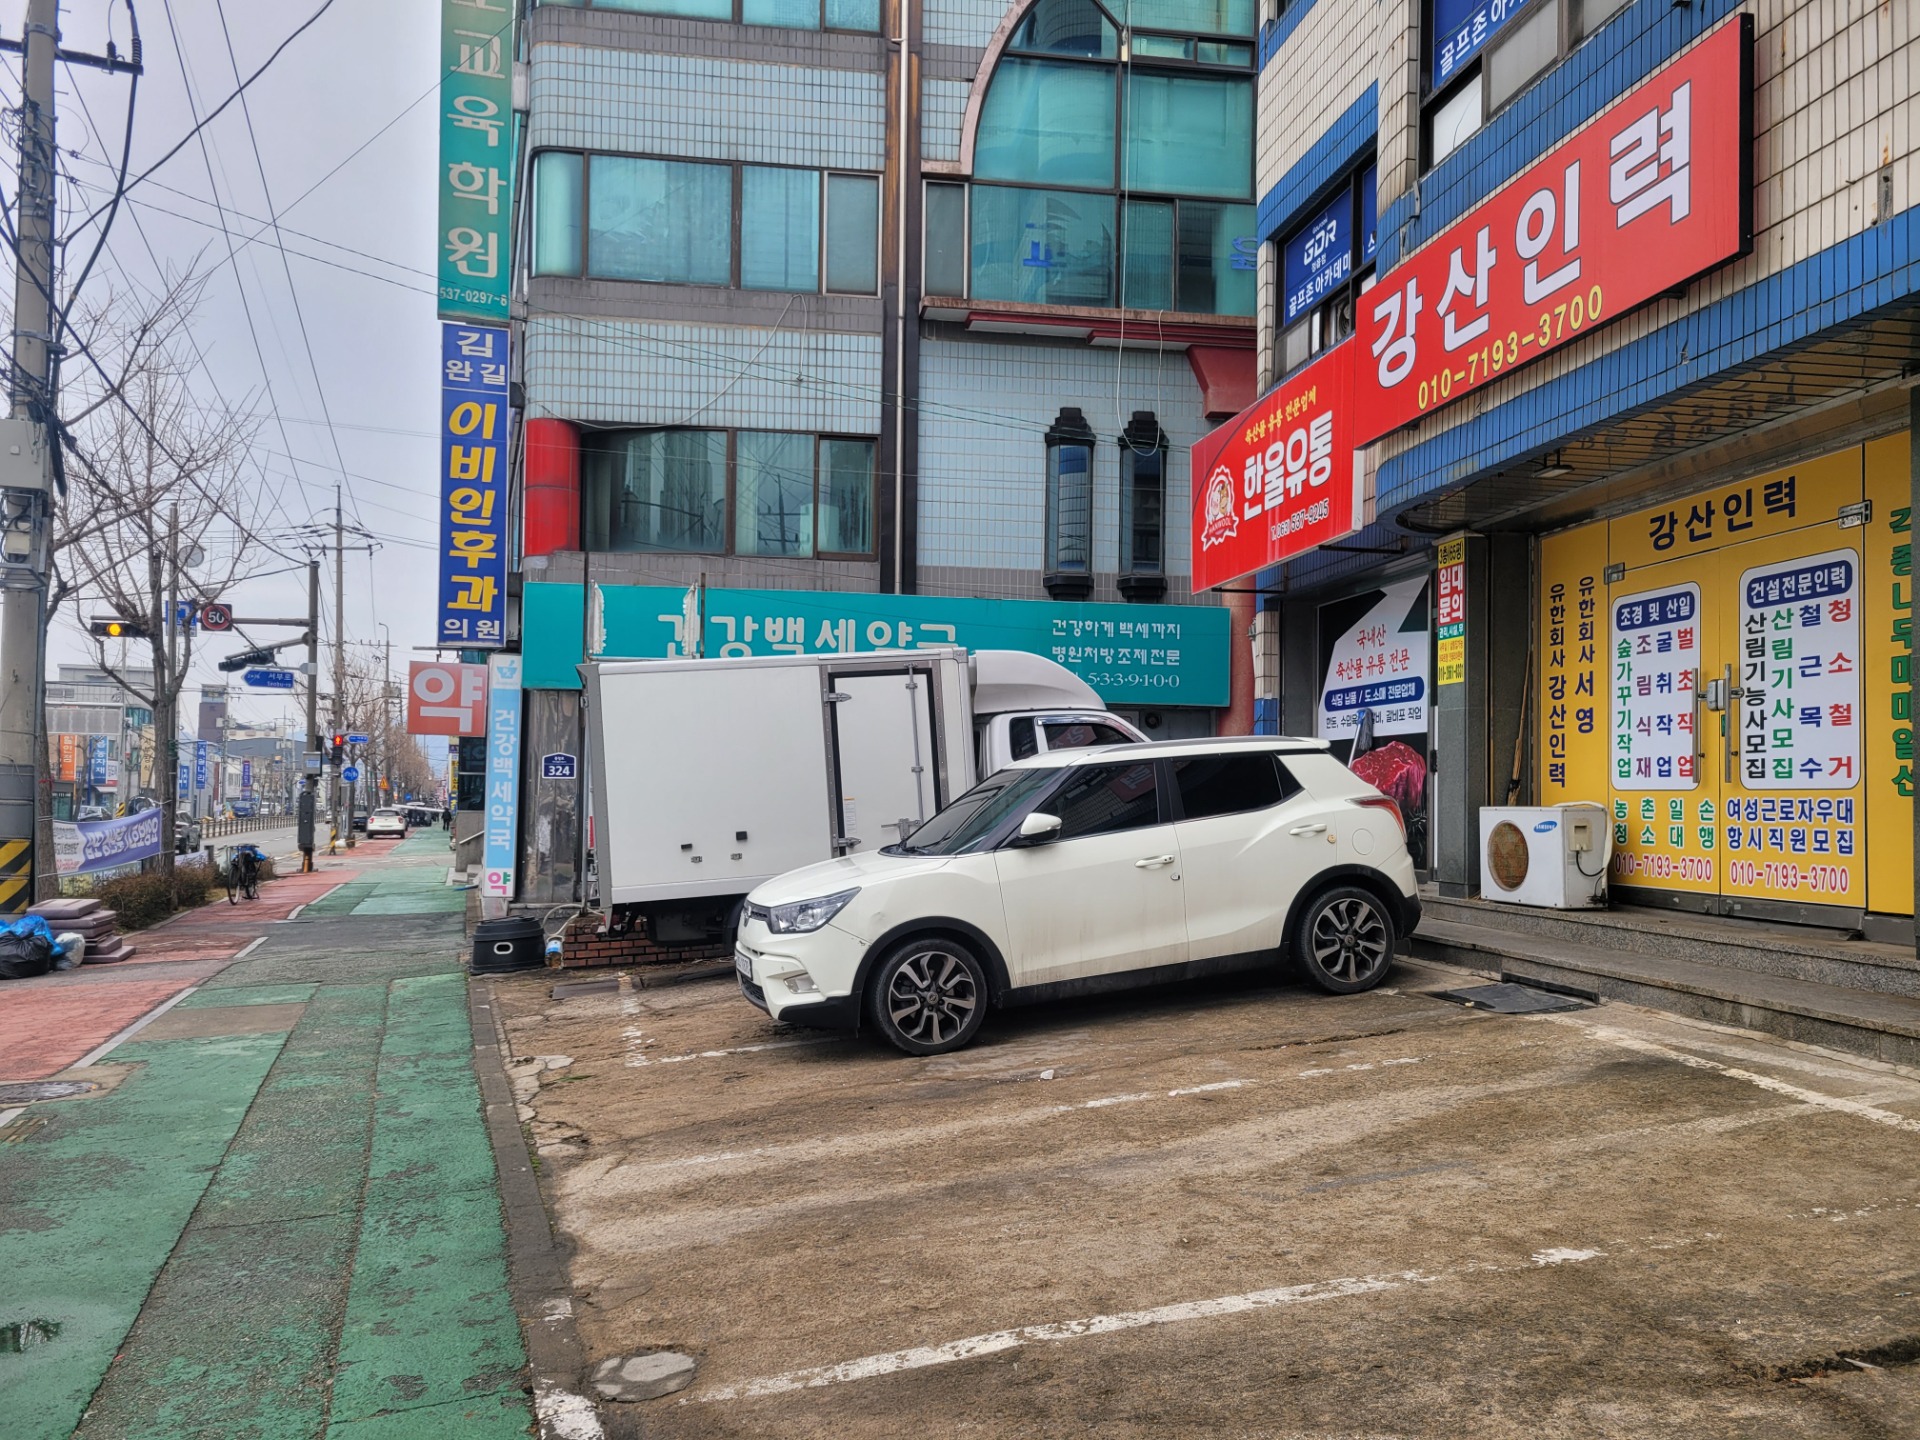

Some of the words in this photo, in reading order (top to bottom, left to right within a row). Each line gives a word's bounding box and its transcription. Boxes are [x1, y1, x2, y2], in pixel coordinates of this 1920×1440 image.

[1441, 10, 1487, 77] 골프존
[1304, 220, 1336, 266] GDR
[1371, 80, 1691, 388] 강산인력
[1289, 282, 1314, 317] 골프존
[1315, 250, 1351, 293] 아카데미
[456, 331, 493, 358] 김
[1418, 285, 1603, 411] 010-7193-3700
[445, 358, 506, 386] 완길
[1245, 419, 1266, 445] 축산물
[1268, 408, 1283, 432] 유통
[1285, 385, 1316, 422] 전문업체
[1244, 410, 1332, 521] 한울유통
[447, 401, 498, 613] 이비인후과
[1648, 476, 1796, 551] 강산인력
[1440, 564, 1463, 595] 임대
[1751, 565, 1846, 604] 건설전문인력
[208, 611, 225, 623] 50
[1440, 593, 1463, 624] 문의
[1550, 583, 1567, 669] 유한회사
[1578, 576, 1595, 664] 유한회사
[1621, 605, 1643, 628] 조경
[1650, 601, 1660, 623] 및
[1666, 594, 1690, 618] 산일
[443, 617, 500, 640] 의원
[1053, 620, 1114, 637] 건강하게
[1120, 622, 1180, 640] 백세까지
[1357, 624, 1386, 651] 국내산
[1336, 657, 1363, 682] 축산물
[1366, 653, 1386, 677] 유통
[1389, 648, 1410, 672] 전문
[413, 668, 483, 733] 약
[1331, 693, 1343, 707] 식당
[1388, 682, 1416, 699] 전문업체
[1408, 706, 1422, 720] 작업
[1575, 671, 1594, 734] 서영
[1617, 638, 1632, 778] 숲가꾸기작업
[1745, 612, 1767, 779] 산림기능사모집
[1771, 608, 1794, 779] 산림기사모집
[1549, 674, 1567, 788] 강산인력
[489, 709, 517, 851] 건강백세약국
[548, 765, 570, 776] 324
[1727, 798, 1854, 824] 여성근로자우대
[1727, 826, 1854, 855] 항시직원모집
[488, 871, 511, 895] 약
[1614, 853, 1714, 883] 010-7193-3700
[1729, 860, 1849, 894] 010-7193-3700
